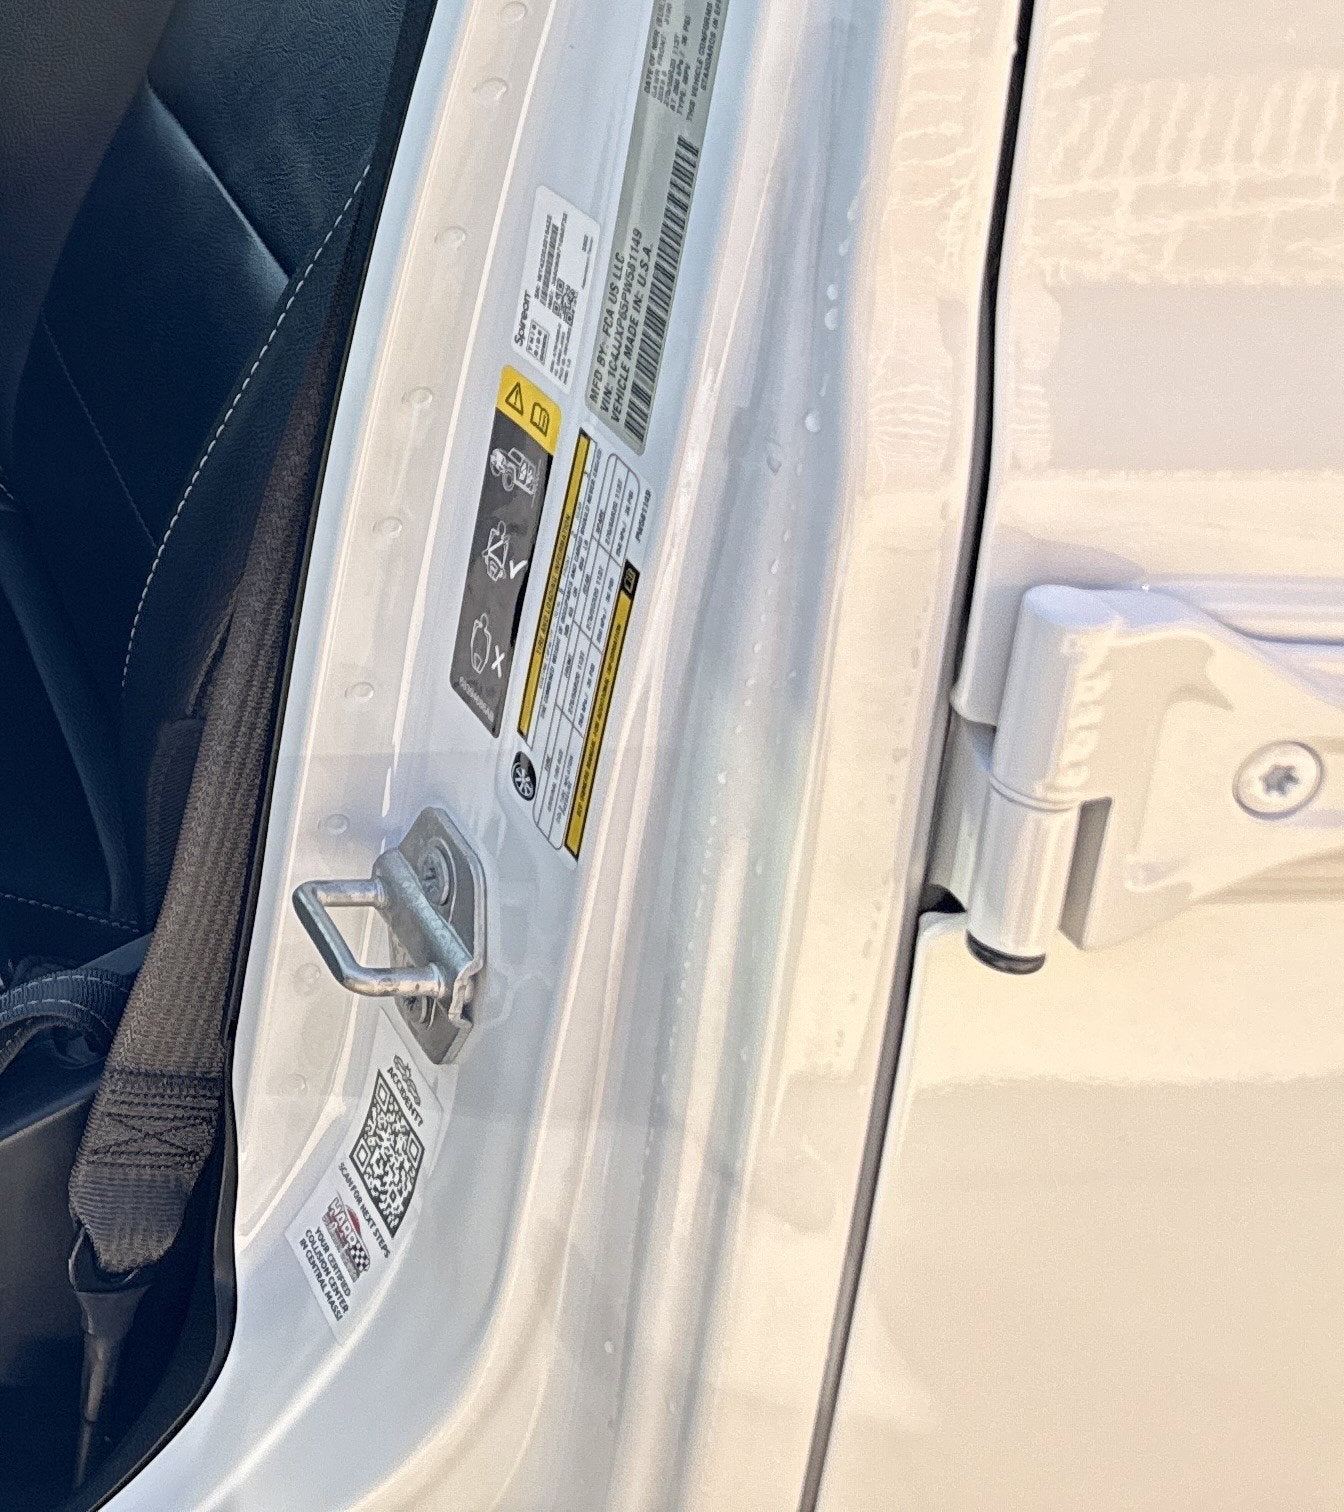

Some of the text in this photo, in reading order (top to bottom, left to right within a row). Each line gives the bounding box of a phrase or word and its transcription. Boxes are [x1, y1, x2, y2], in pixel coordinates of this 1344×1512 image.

[611, 250, 625, 281] LLC
[607, 280, 619, 305] US
[601, 306, 614, 337] FCA
[589, 367, 602, 404] MFD
[611, 359, 629, 424] VEHICLE
[622, 314, 638, 361] MADE
[387, 1067, 423, 1127] ACCIDENT?
[338, 1162, 354, 1187] SCAN
[359, 1201, 377, 1230] NEXT
[372, 1226, 392, 1259] STEPS
[305, 1229, 331, 1278] COLLISION
[328, 1274, 350, 1314] CENTER
[305, 1252, 327, 1296] CENTRAL
[315, 1226, 331, 1254] YOUR
[327, 1251, 352, 1297] CERTIFIED
